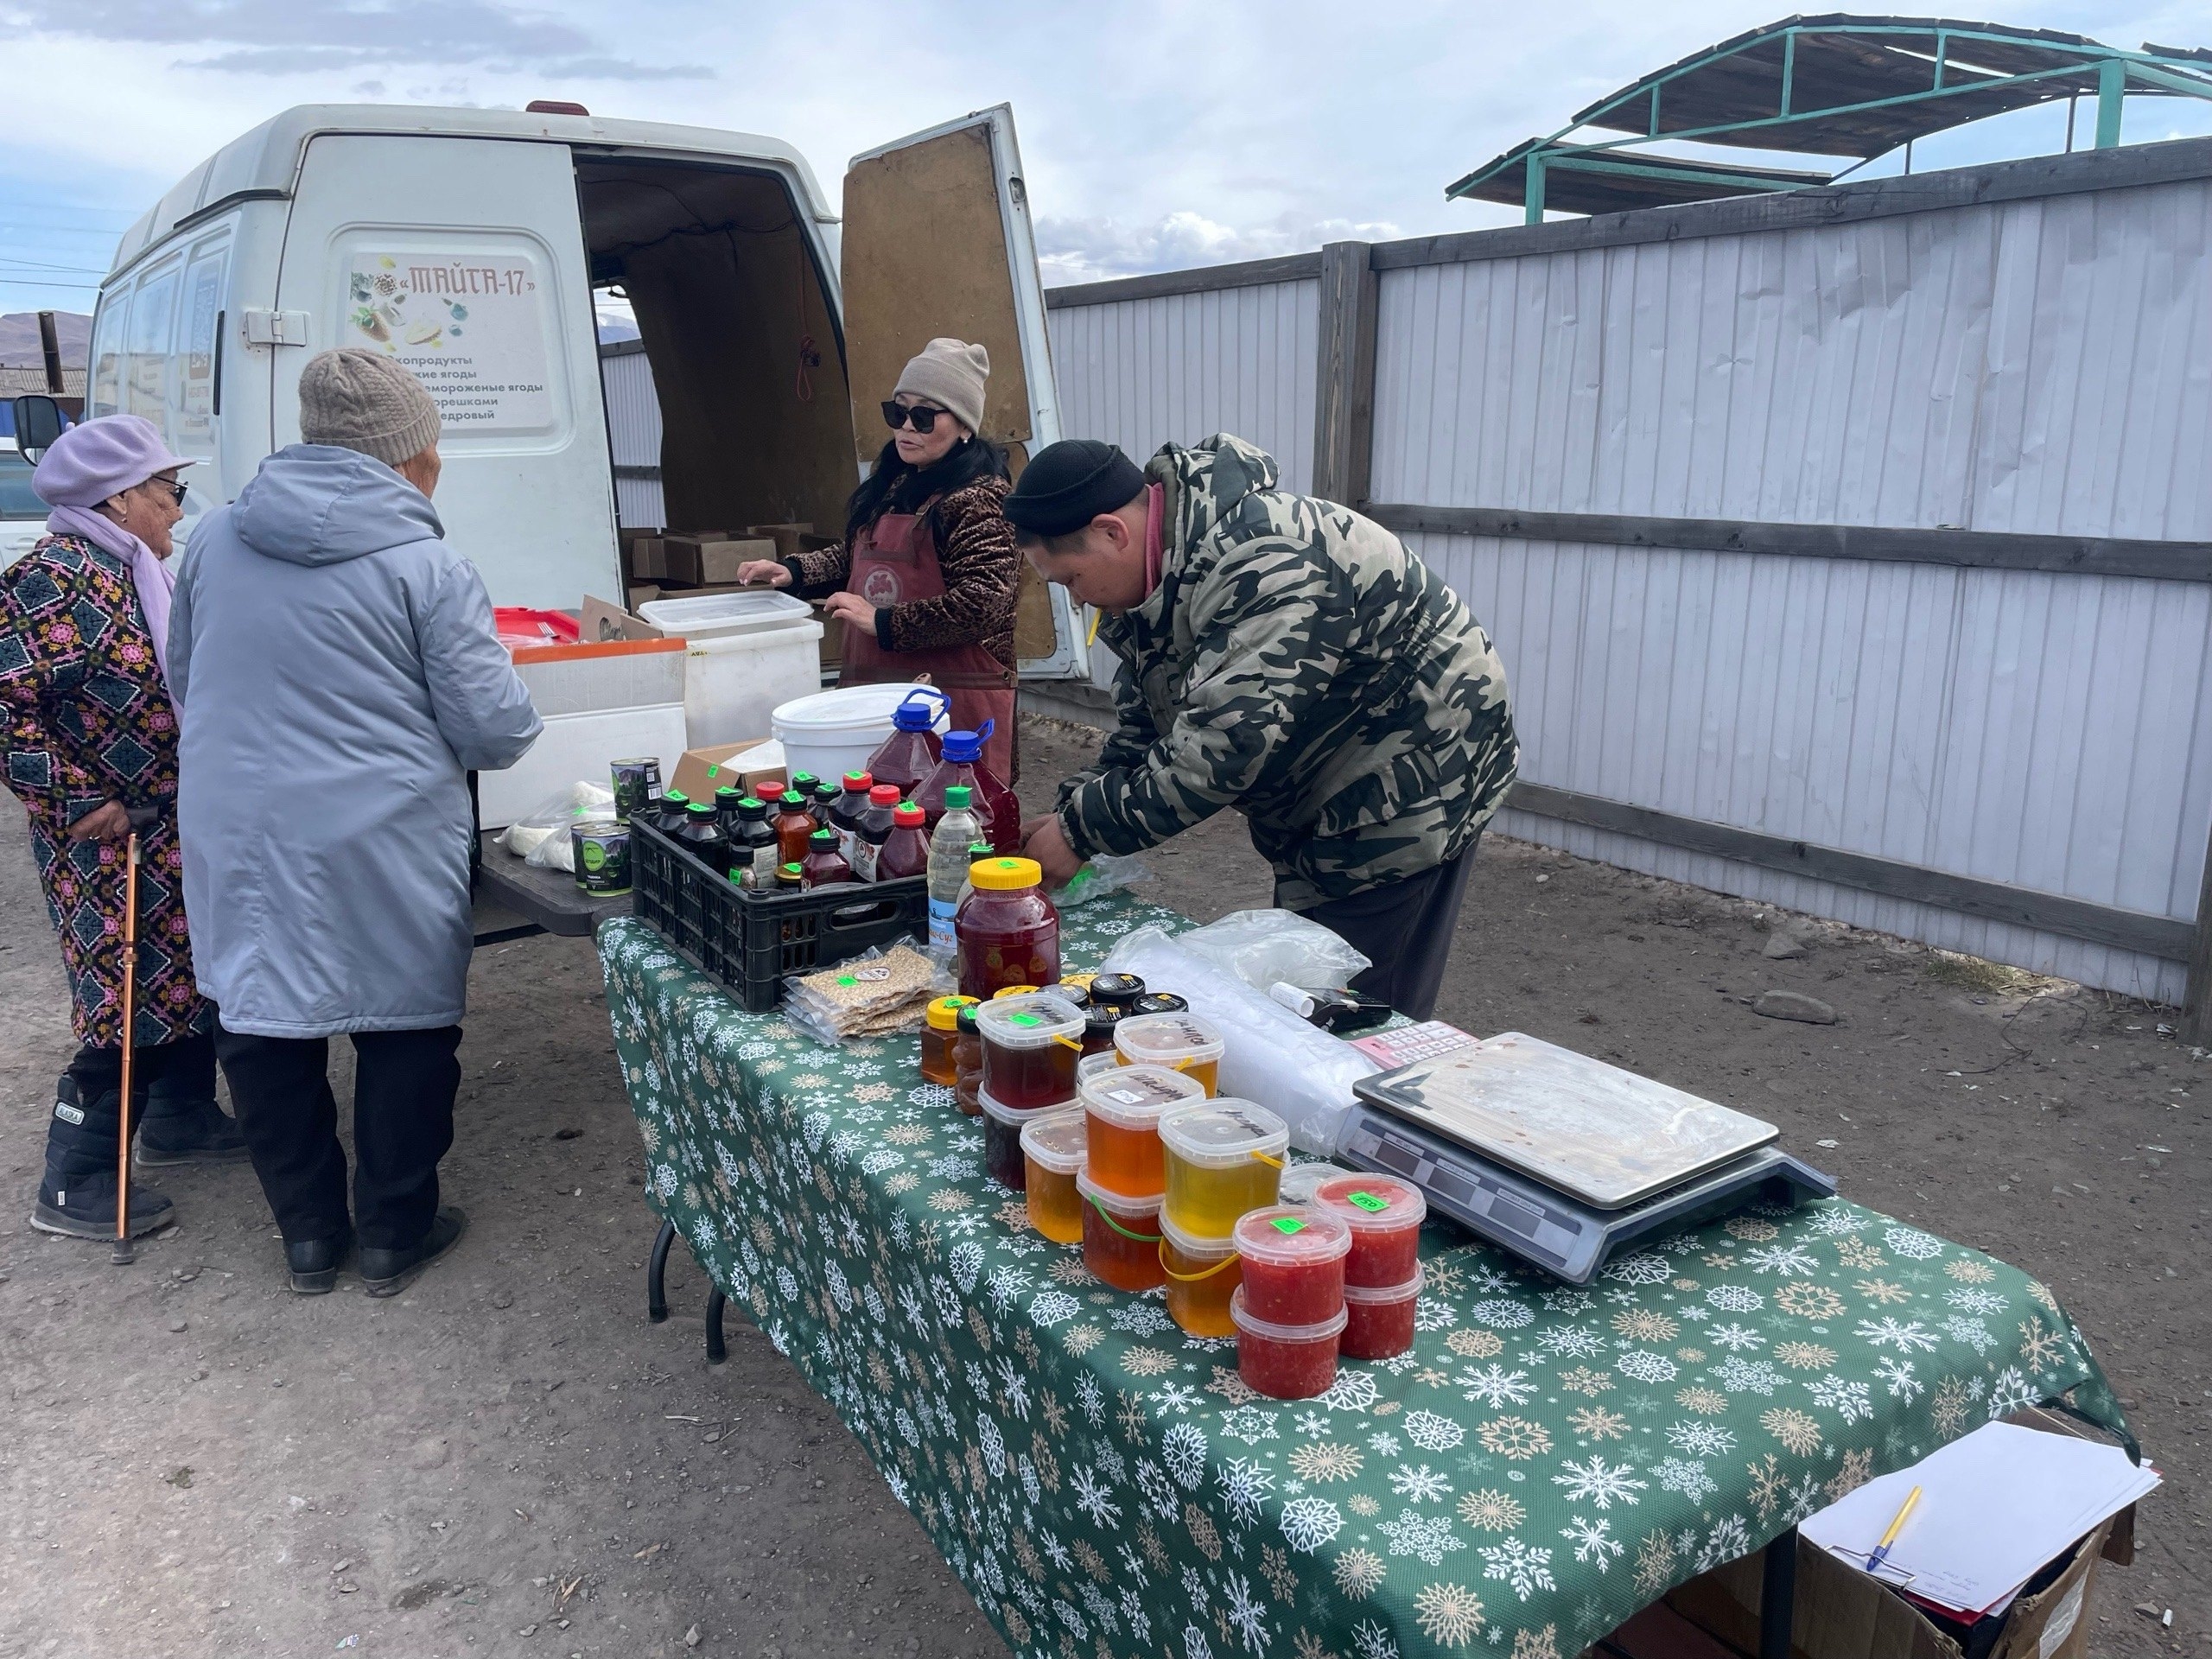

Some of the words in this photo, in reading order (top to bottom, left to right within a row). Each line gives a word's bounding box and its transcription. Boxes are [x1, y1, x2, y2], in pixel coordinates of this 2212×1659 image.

[441, 372, 477, 380] ягоды
[425, 385, 505, 395] емороженые
[508, 385, 543, 393] ягоды
[441, 410, 495, 423] едровый
